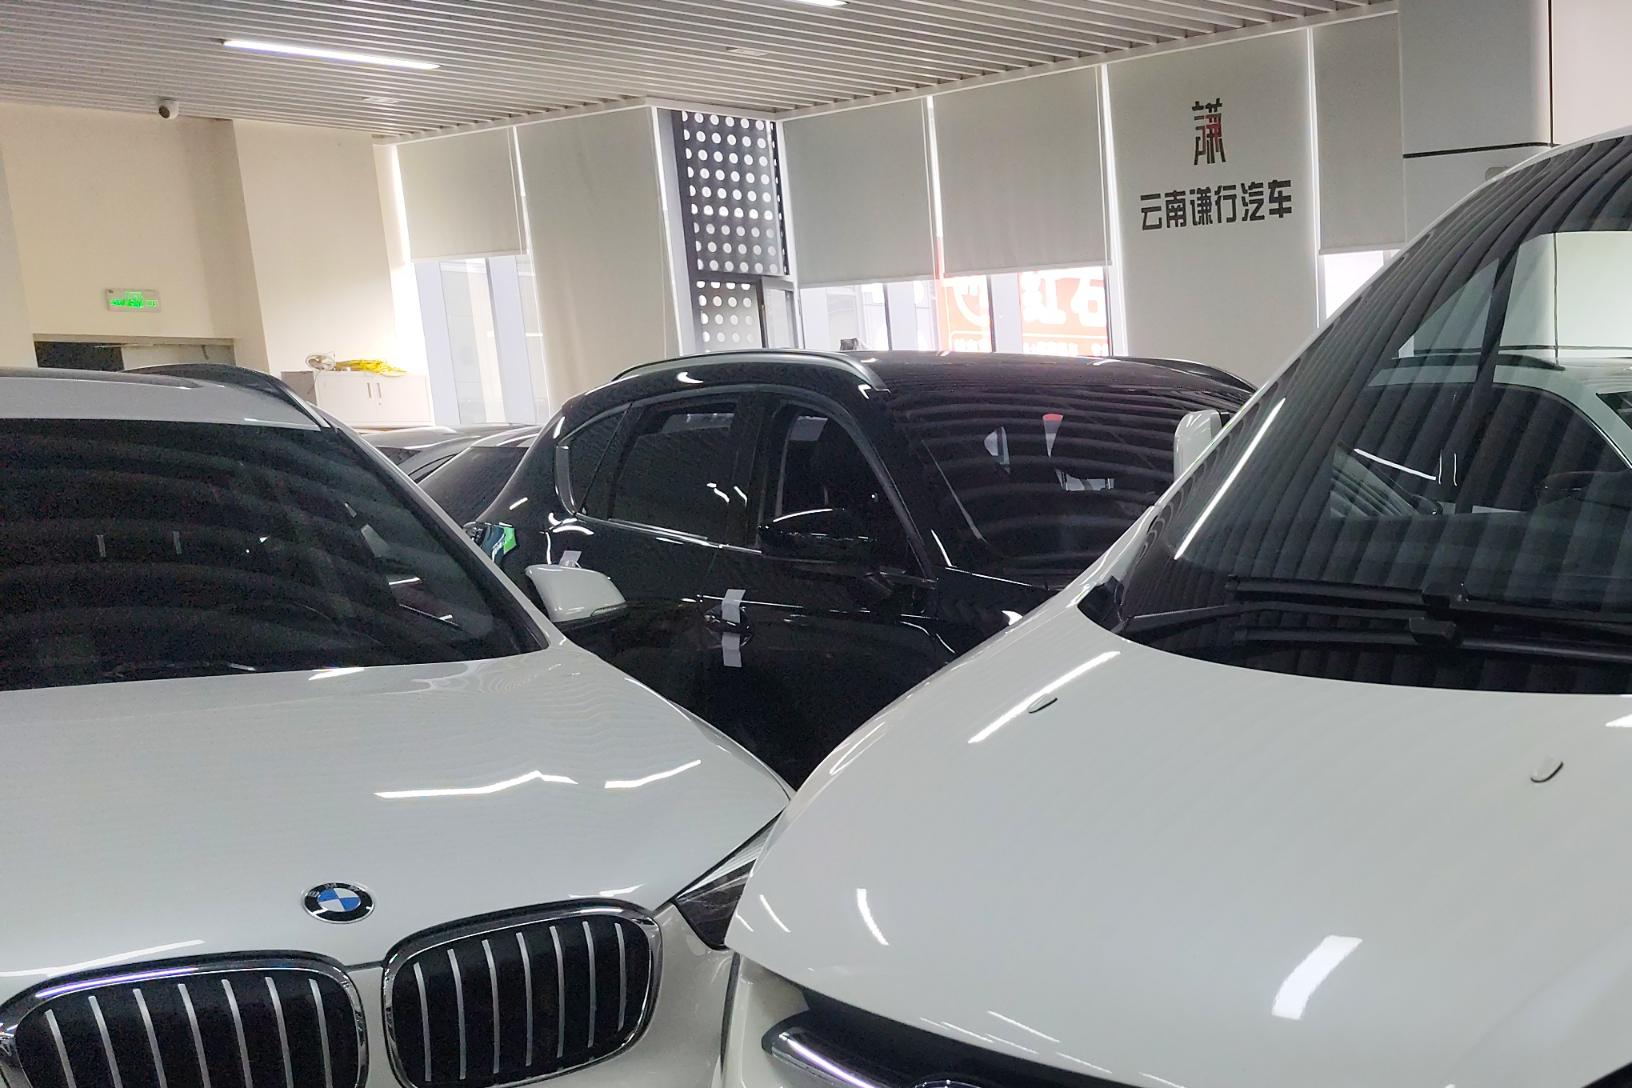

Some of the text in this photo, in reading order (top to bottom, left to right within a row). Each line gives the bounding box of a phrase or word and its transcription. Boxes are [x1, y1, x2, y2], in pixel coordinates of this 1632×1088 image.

[1140, 179, 1293, 231] 云南谦行汽车
